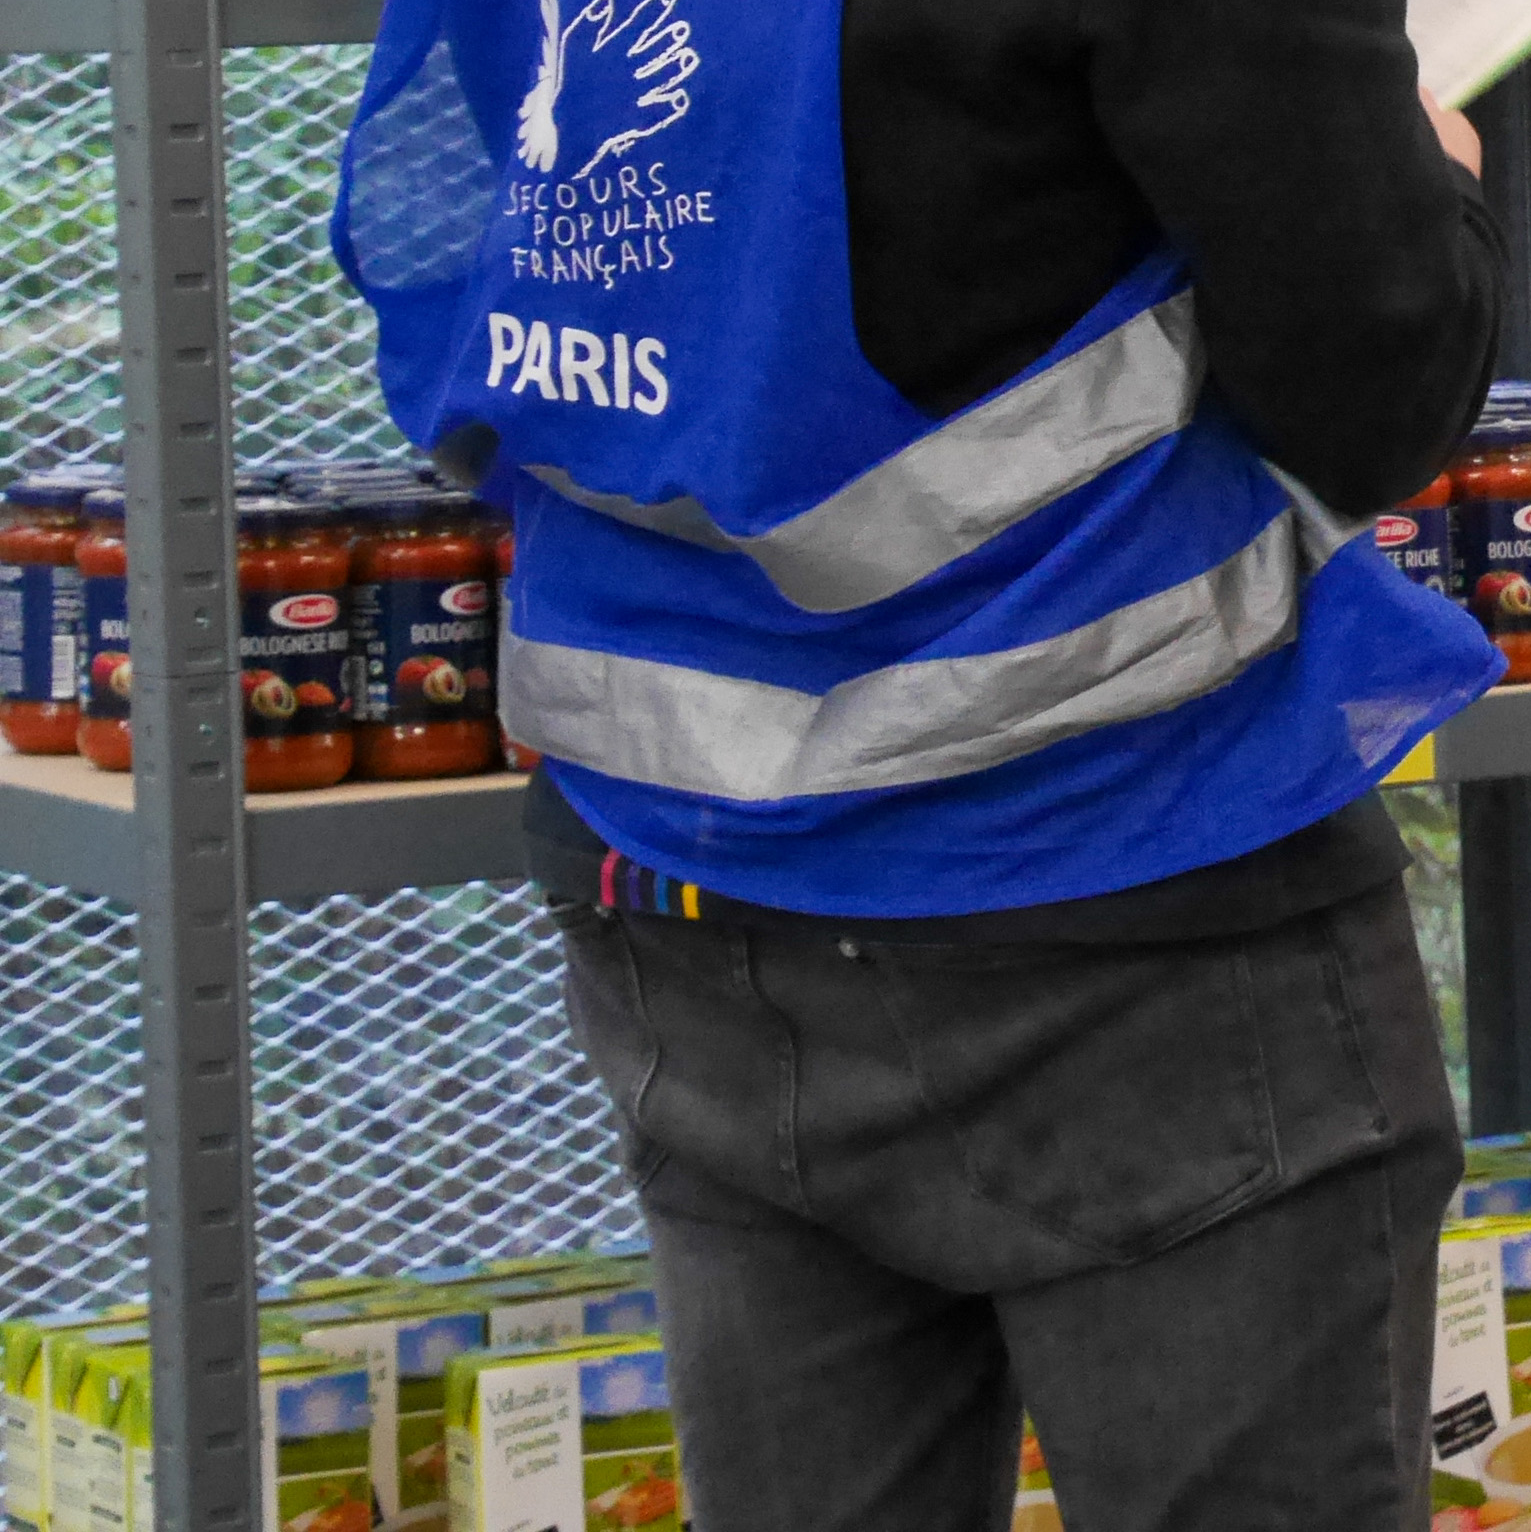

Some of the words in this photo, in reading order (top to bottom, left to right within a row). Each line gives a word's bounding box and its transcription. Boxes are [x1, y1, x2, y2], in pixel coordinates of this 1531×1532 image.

[503, 163, 667, 217] SECOURS
[532, 191, 715, 246] POPULAIRE
[510, 235, 675, 288] FRANÇAIS
[486, 311, 670, 416] PARIS
[1405, 548, 1440, 568] RICHE
[239, 632, 326, 657] BOLOGNESE
